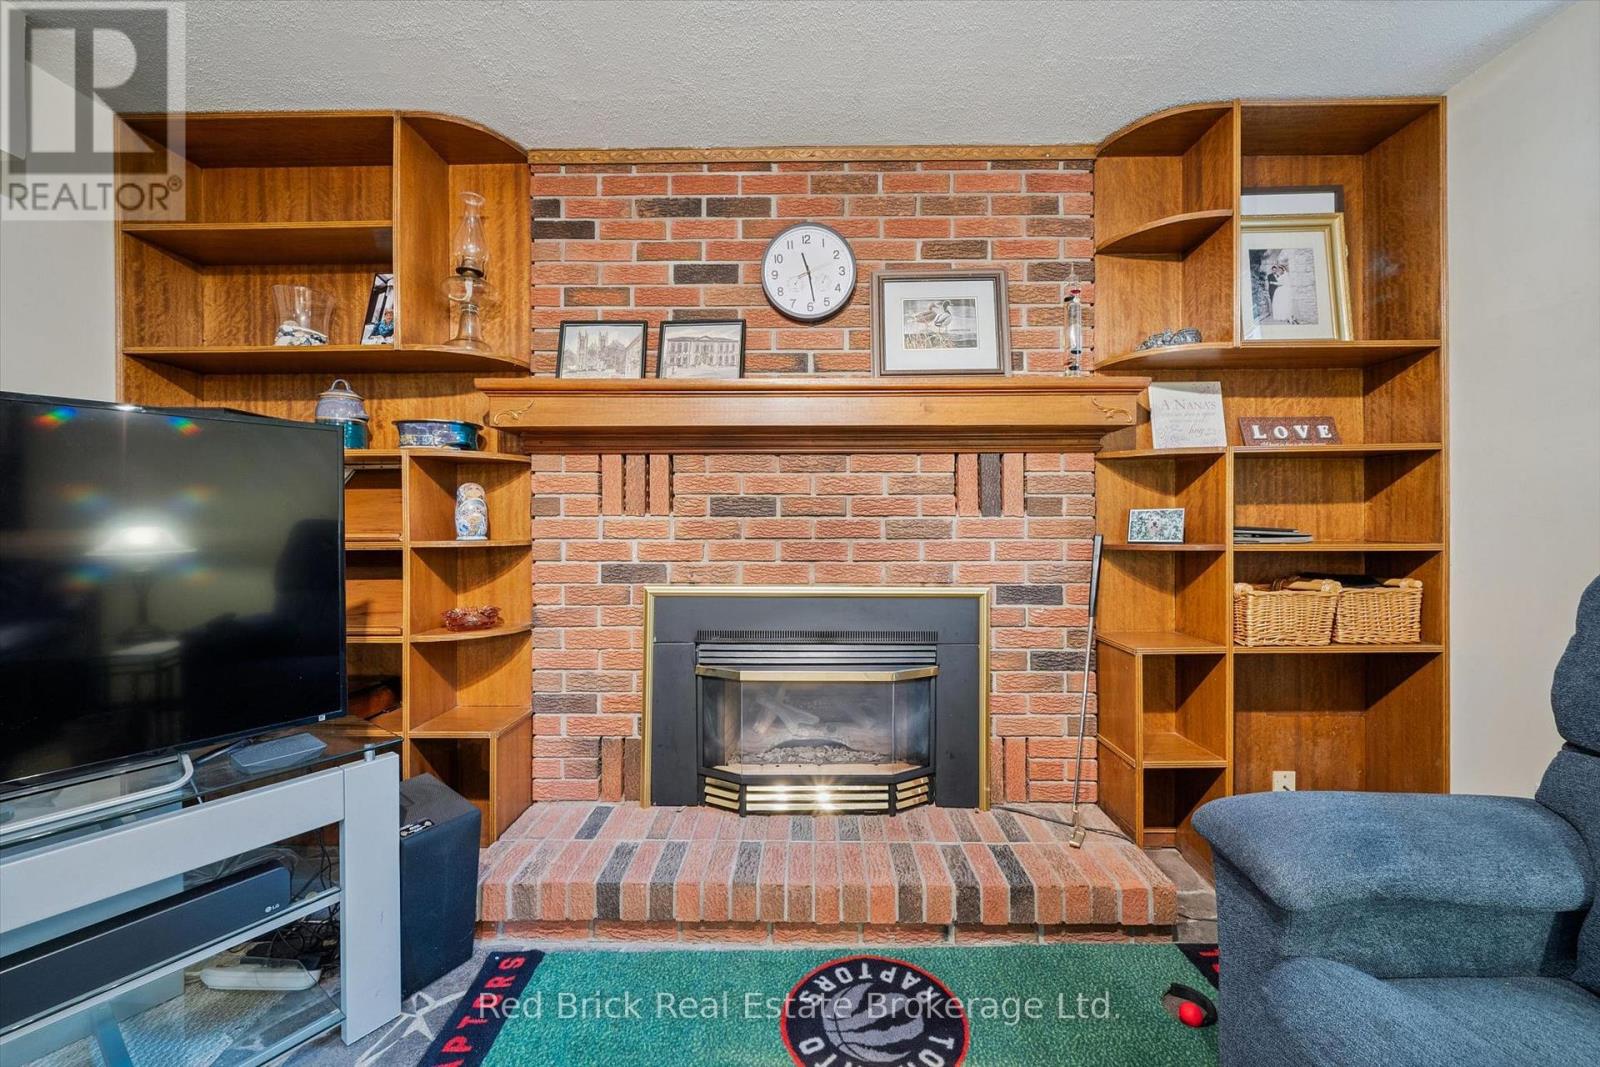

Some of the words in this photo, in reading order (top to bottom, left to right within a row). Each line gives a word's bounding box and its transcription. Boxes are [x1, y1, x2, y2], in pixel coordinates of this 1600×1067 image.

[801, 234, 811, 244] 12
[786, 240, 794, 250] 11
[773, 254, 784, 264] 10
[832, 249, 840, 260] 2
[771, 270, 779, 280] 9
[838, 266, 846, 276] 3
[777, 287, 784, 297] 8
[834, 283, 841, 293] 4
[790, 298, 797, 308] 7
[806, 302, 814, 312] 6
[823, 297, 830, 307] 5
[1251, 424, 1332, 439] LOVE
[799, 962, 941, 1007] RAPTORS
